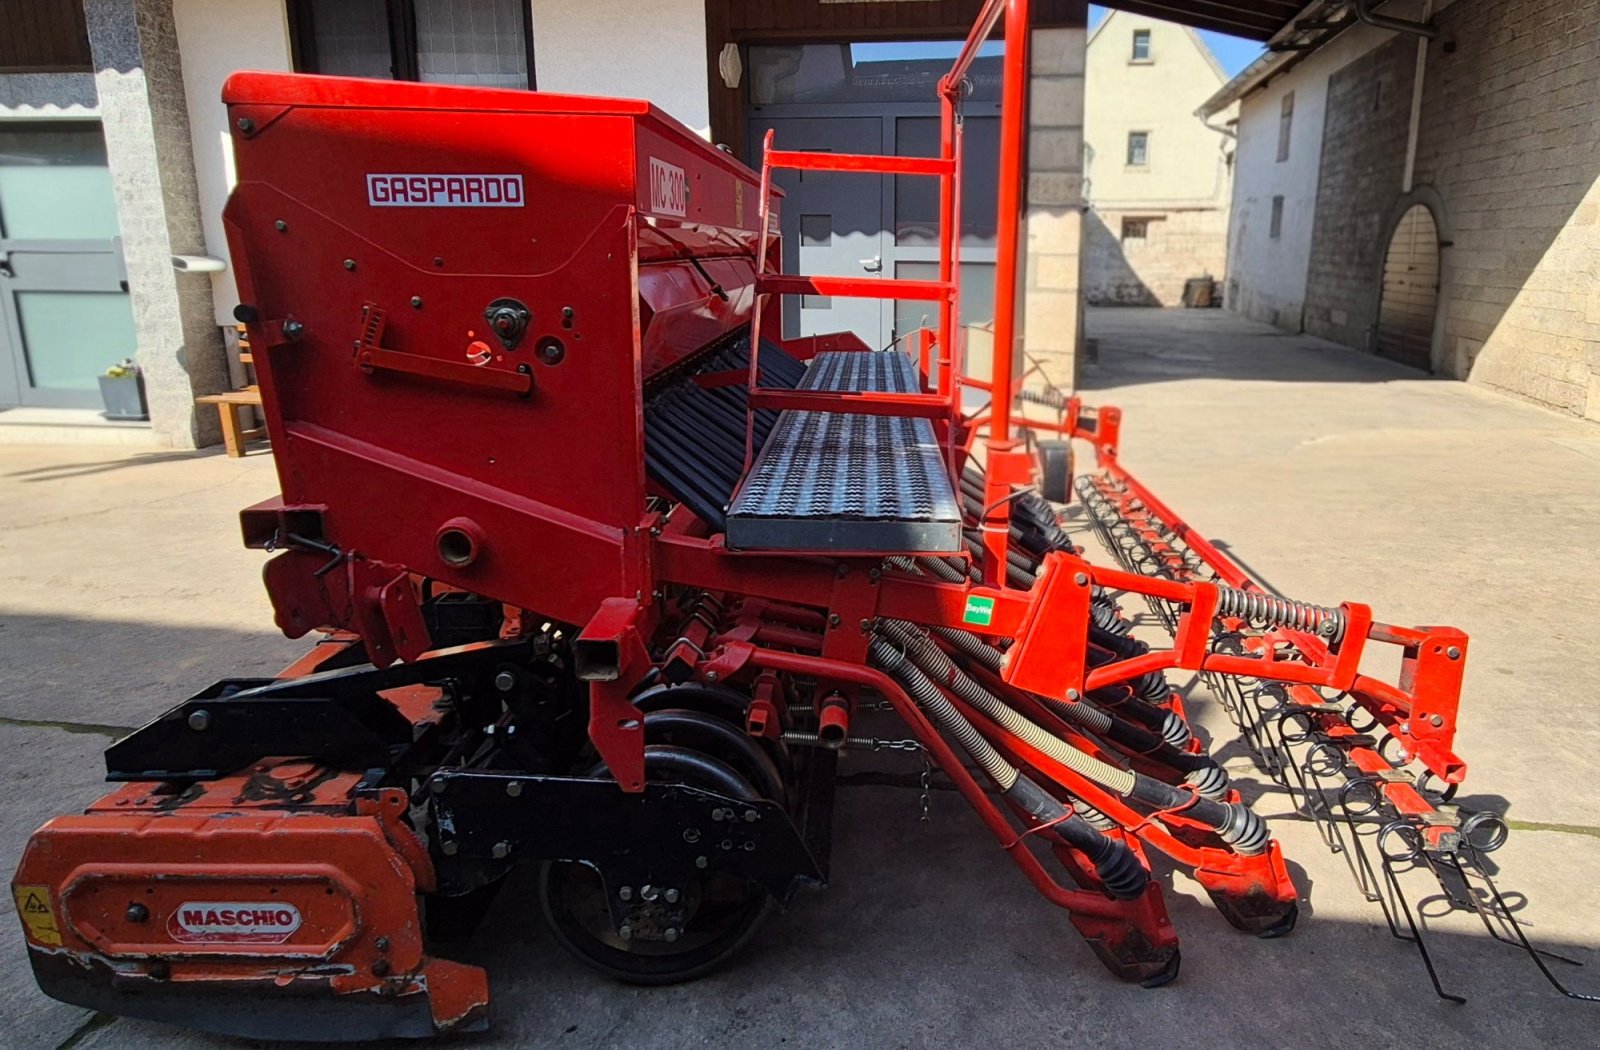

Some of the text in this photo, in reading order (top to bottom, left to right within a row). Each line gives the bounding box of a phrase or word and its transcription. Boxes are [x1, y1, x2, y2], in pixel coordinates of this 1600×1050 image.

[371, 177, 521, 203] GASPARDO
[651, 163, 684, 211] MC 300
[183, 910, 293, 926] MASCHIO
